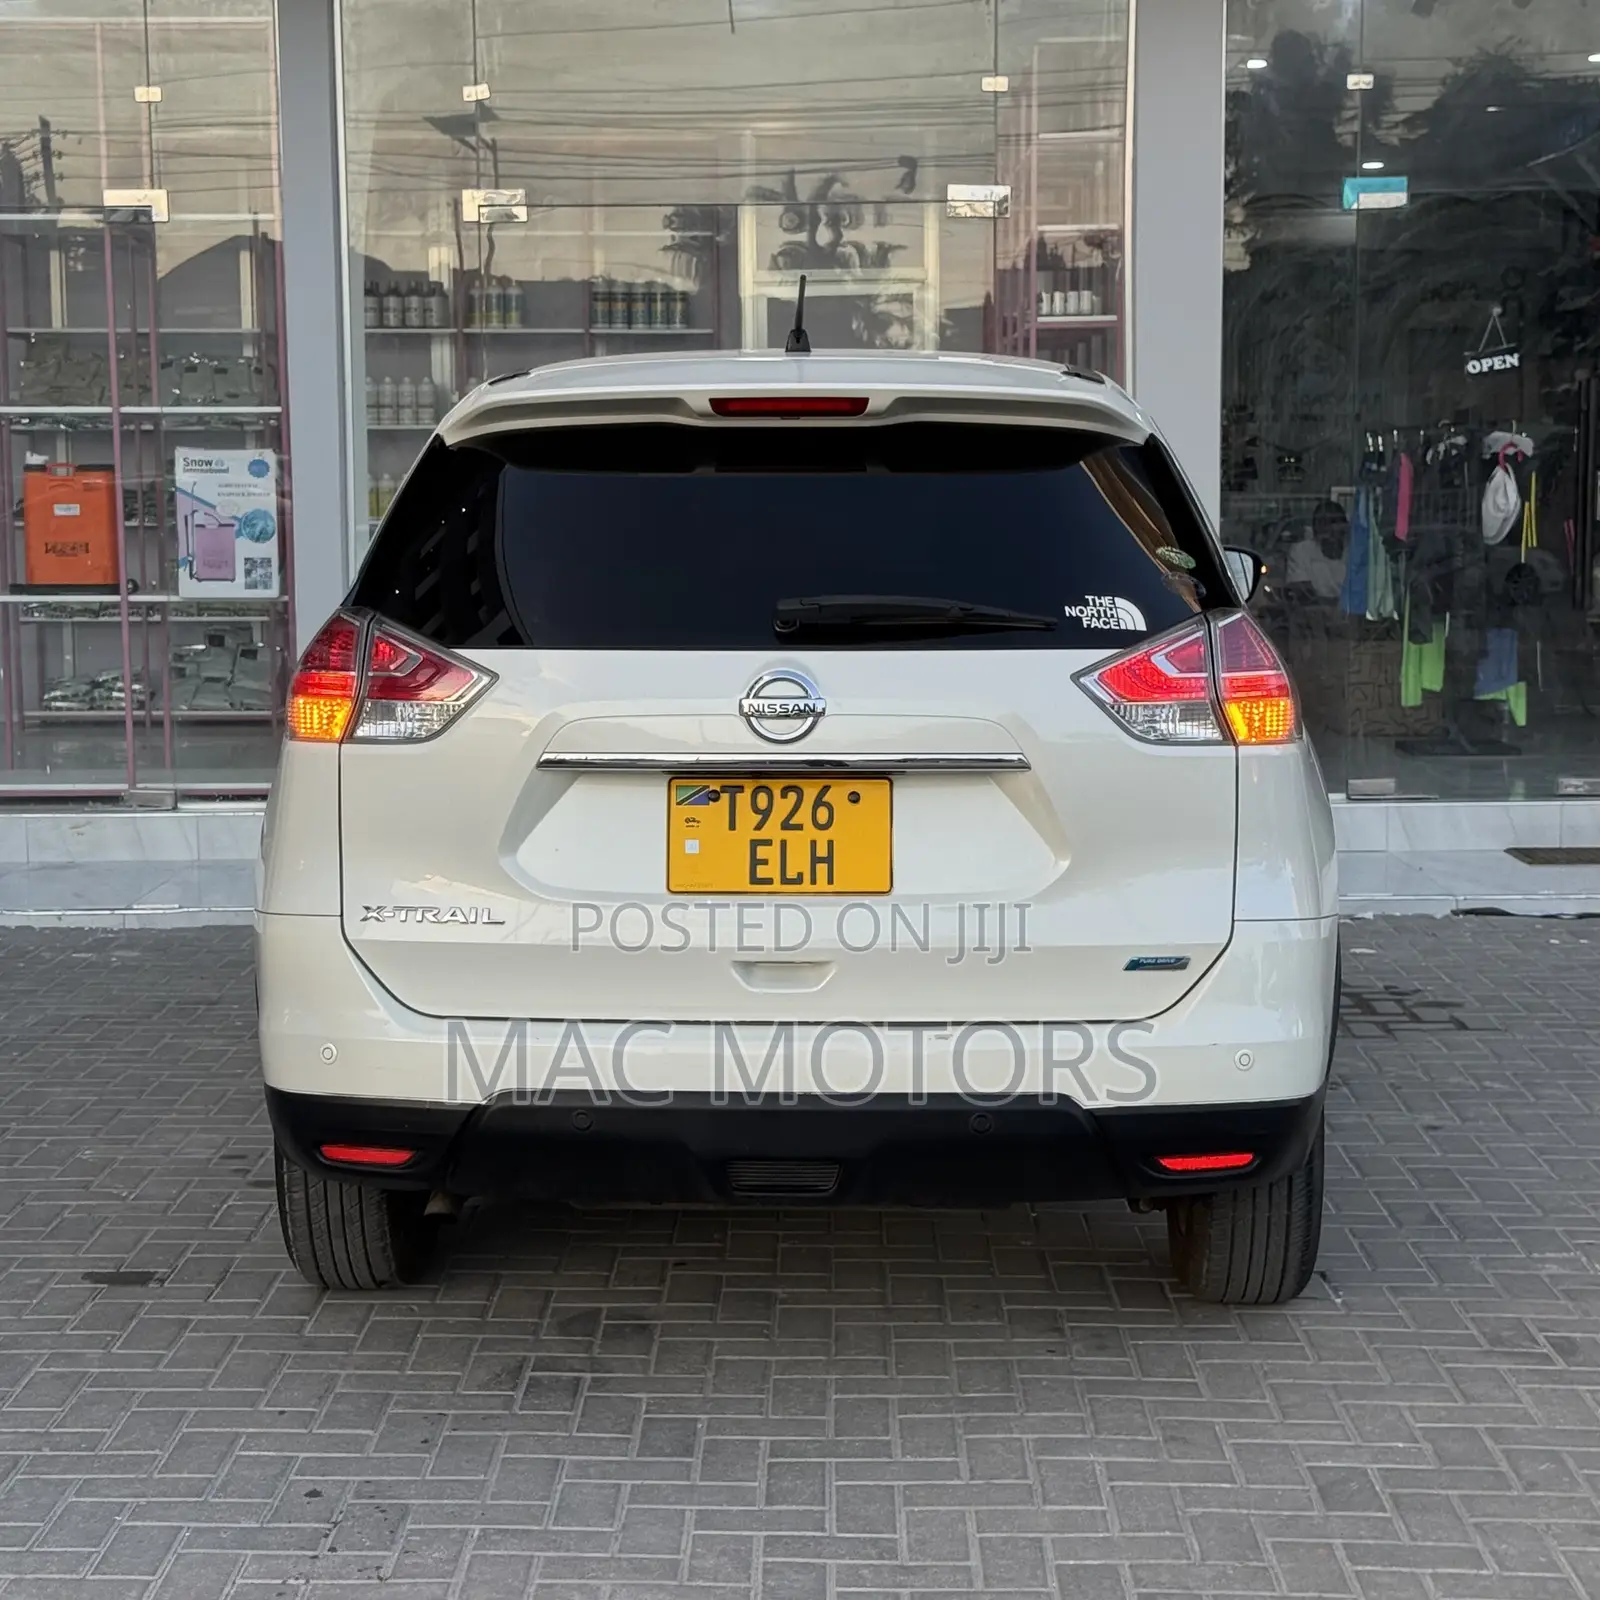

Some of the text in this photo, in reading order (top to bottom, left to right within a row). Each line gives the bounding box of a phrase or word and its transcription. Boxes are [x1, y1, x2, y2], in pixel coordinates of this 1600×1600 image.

[1467, 353, 1519, 374] OPEN
[183, 457, 213, 467] Snow
[1085, 595, 1114, 607] THE
[1064, 606, 1117, 618] NORTH
[1082, 617, 1120, 630] FACE
[748, 703, 817, 715] NISSAN
[720, 785, 835, 831] T926
[749, 839, 835, 886] ELH
[360, 905, 506, 925] X-TRAIL
